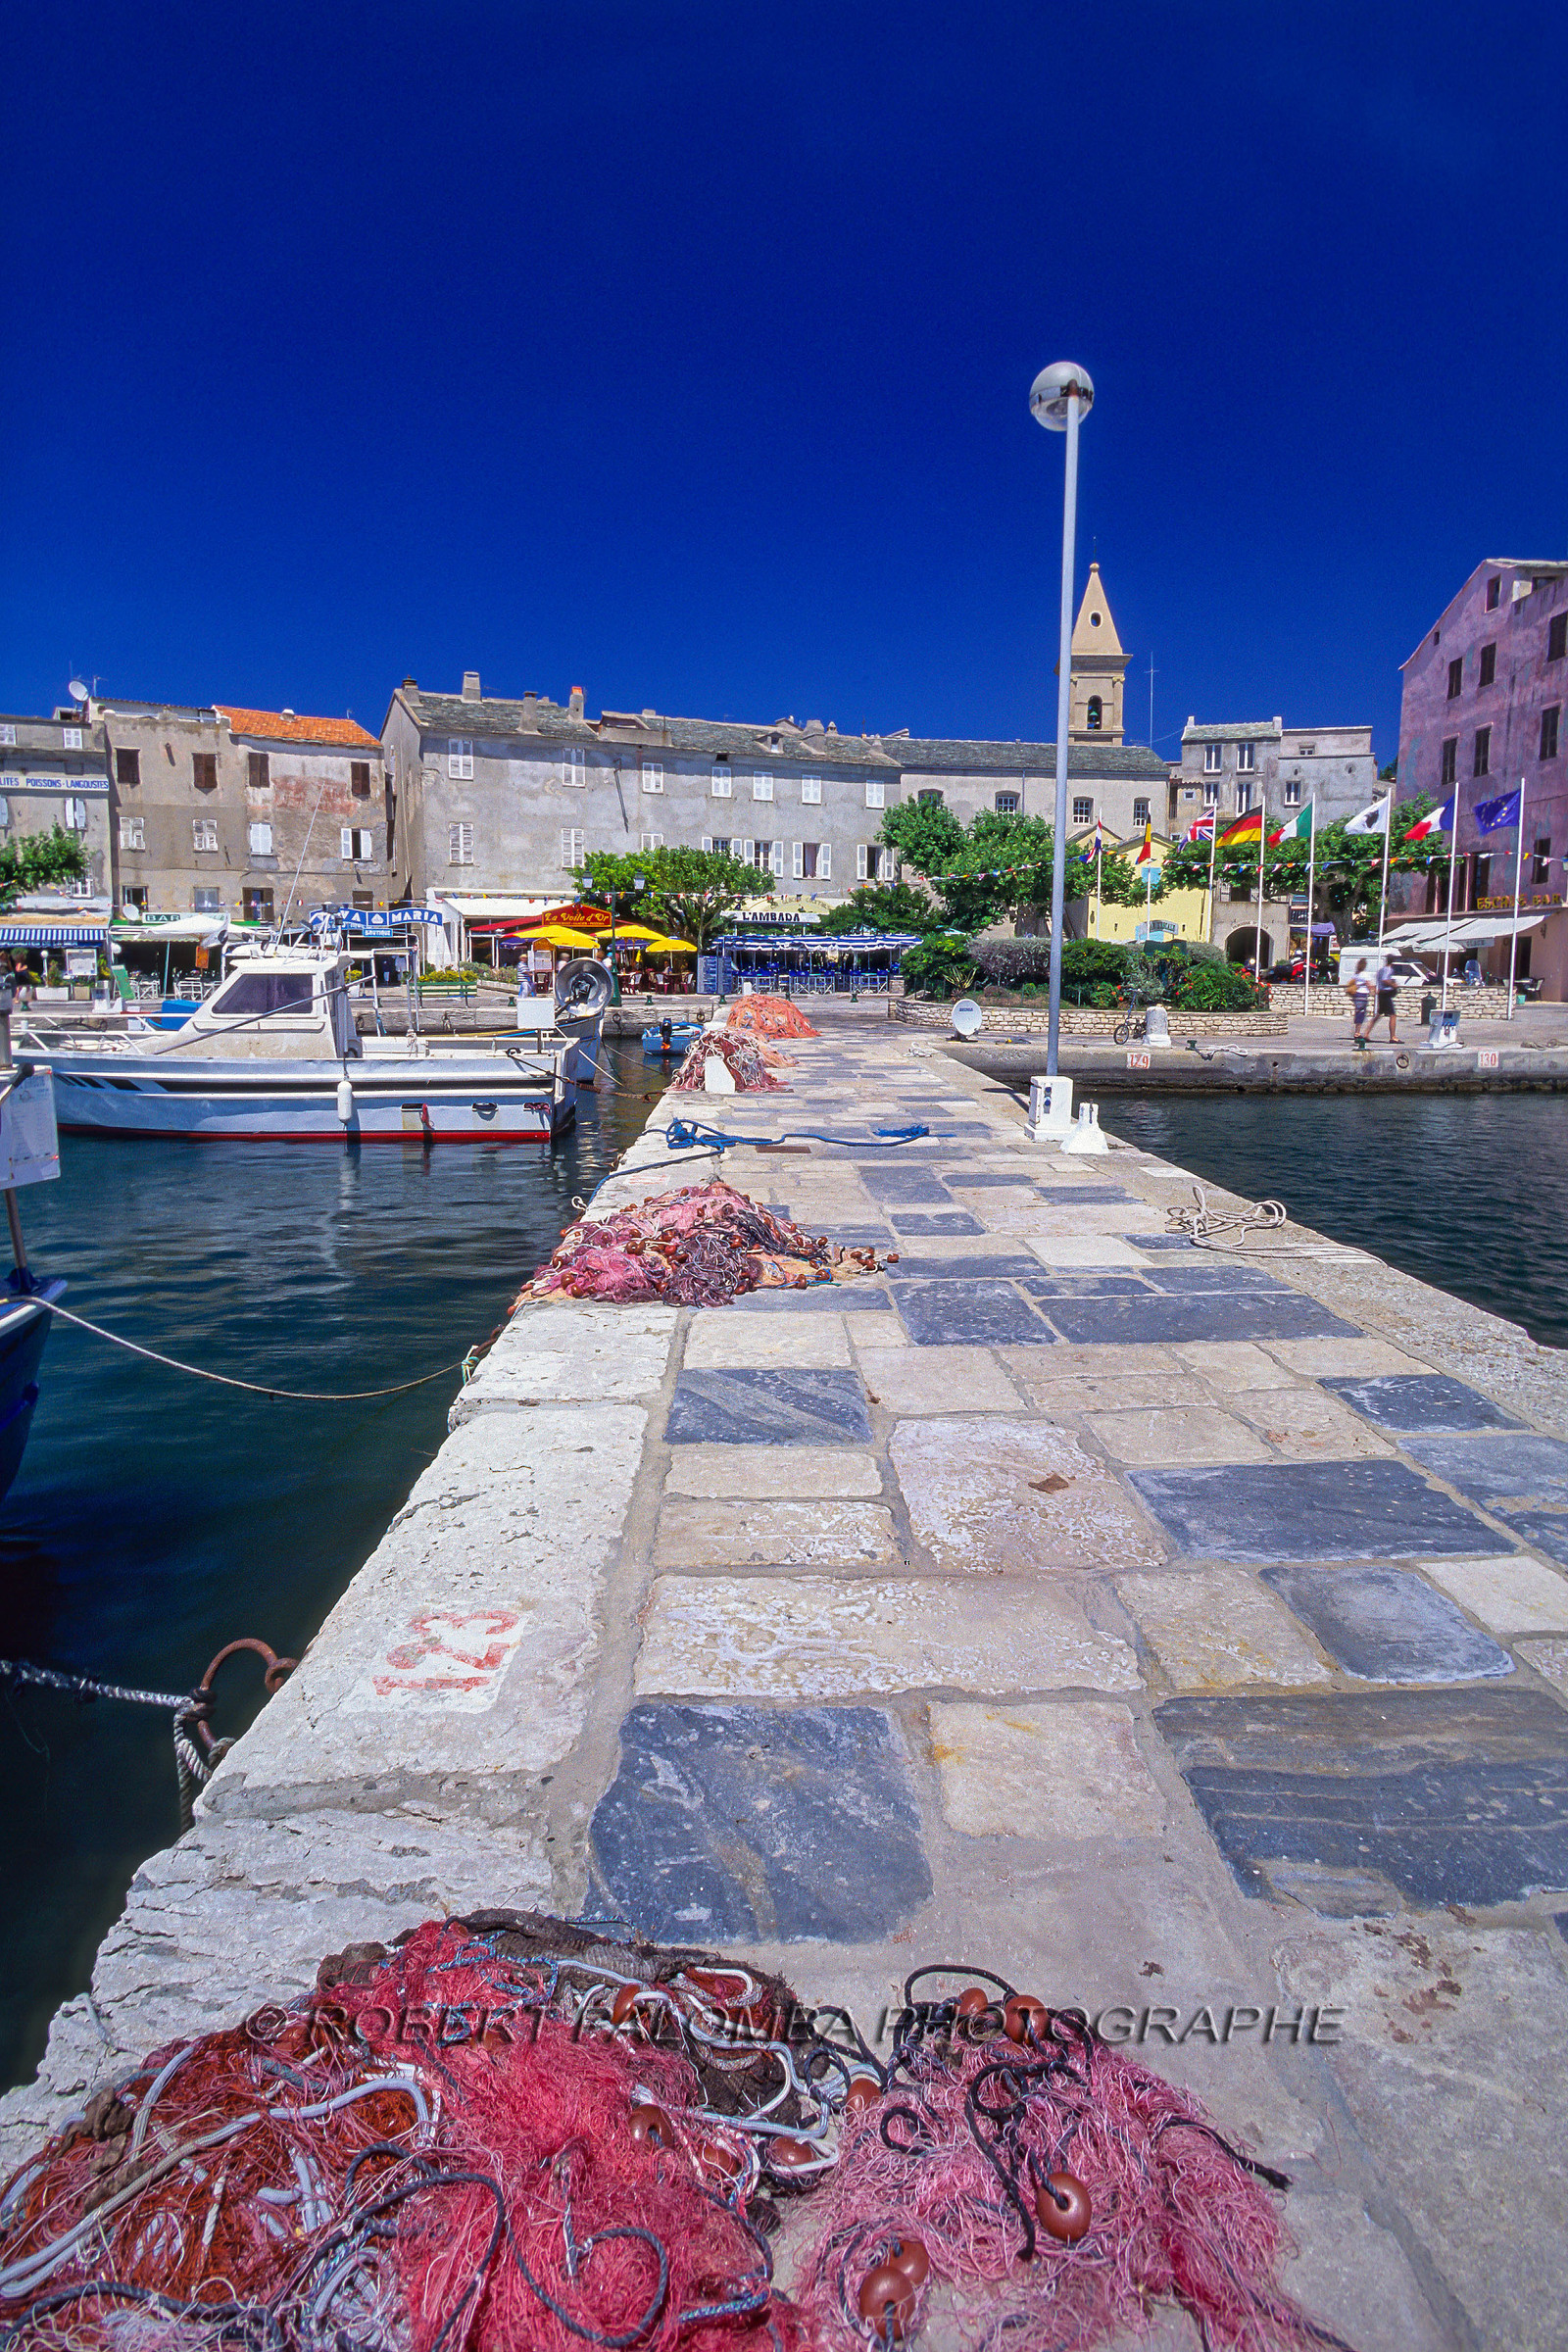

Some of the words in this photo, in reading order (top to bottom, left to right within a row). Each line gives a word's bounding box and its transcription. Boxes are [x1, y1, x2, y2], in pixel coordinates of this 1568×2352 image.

[25, 778, 62, 788] POISSONS
[1532, 893, 1561, 906] BAR
[391, 910, 439, 923] MARIA
[544, 912, 558, 922] La
[561, 912, 585, 922] Voile
[742, 911, 801, 922] L'AMBADA
[1480, 1052, 1497, 1067] 130
[371, 1609, 519, 1695] 123
